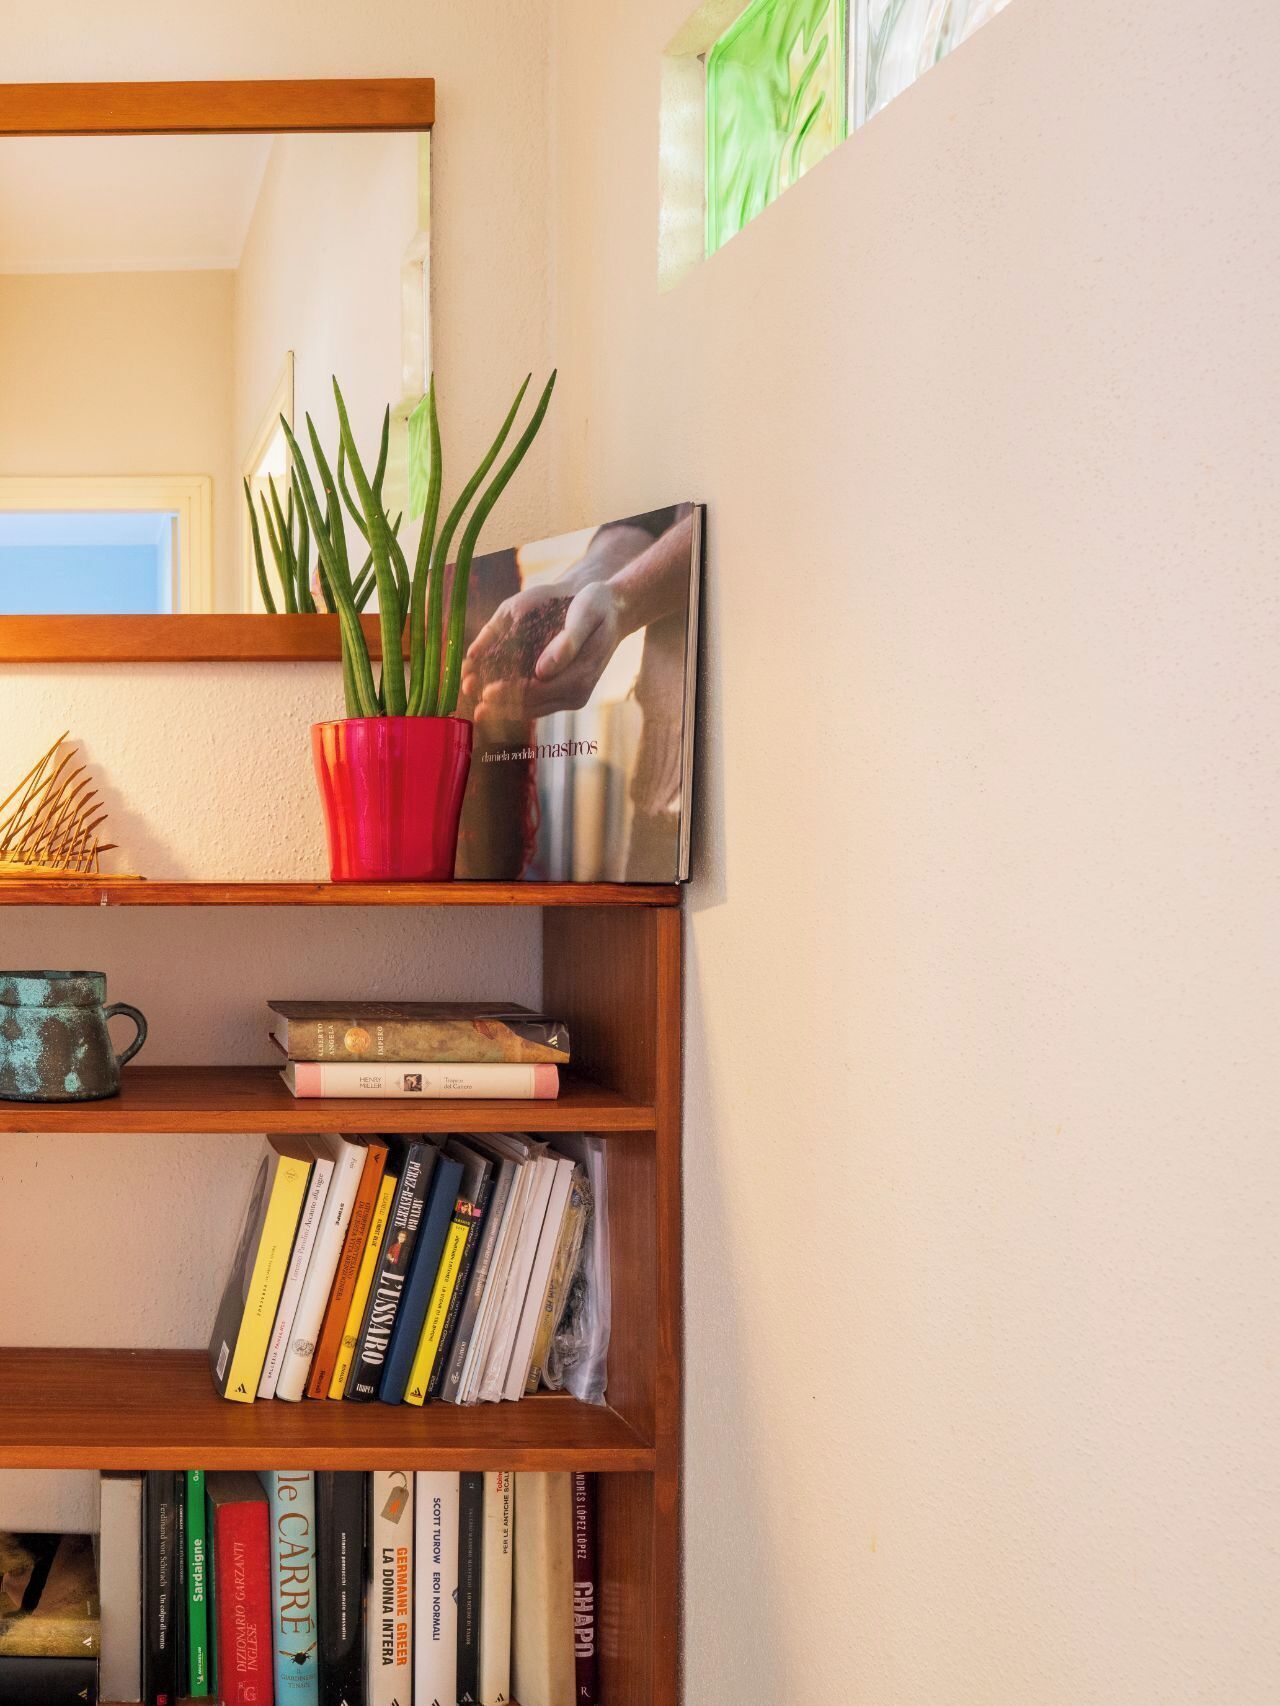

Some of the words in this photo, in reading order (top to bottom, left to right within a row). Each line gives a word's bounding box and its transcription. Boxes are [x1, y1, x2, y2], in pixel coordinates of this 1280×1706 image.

[481, 751, 509, 763] daniela
[536, 739, 598, 759] mastros
[316, 1022, 324, 1057] ALBERTO
[327, 1024, 336, 1056] ANGELA
[376, 1025, 385, 1056] IMPERO
[312, 1188, 321, 1201] alla
[316, 1173, 325, 1188] tigre
[394, 1161, 422, 1229] PÉREZ-REVERTE
[303, 1202, 317, 1229] Accanto
[352, 1207, 364, 1237] QUESTA
[358, 1202, 371, 1236] GIUSEPPE
[407, 1198, 424, 1231] ARTURO
[347, 1238, 364, 1280] MONTESANO
[348, 1237, 357, 1253] VITA
[291, 1253, 305, 1282] Lorenzo
[361, 1269, 406, 1365] L'USSARO
[277, 1473, 311, 1502] le
[159, 1503, 168, 1540] Ferdinand
[432, 1497, 442, 1527] SCOTT
[576, 1504, 587, 1531] LÓPEZ
[432, 1529, 441, 1564] TUROW
[503, 1528, 509, 1538] LE
[576, 1533, 588, 1560] LÓPEZ
[159, 1556, 168, 1587] Schirach
[192, 1538, 204, 1602] Sardaigne
[382, 1547, 395, 1564] LA
[233, 1542, 247, 1602] GARZANTI
[277, 1512, 316, 1635] CARRÉ
[396, 1547, 408, 1617] GERMAINE
[432, 1571, 441, 1594] EROI
[160, 1594, 167, 1603] Un
[382, 1568, 395, 1614] DONNA
[157, 1604, 167, 1623] colpo
[432, 1597, 441, 1641] NORMALI
[573, 1581, 595, 1657] CHAPO
[235, 1605, 248, 1673] DIZIONARIO
[246, 1623, 259, 1672] INGLESE
[382, 1618, 394, 1667] INTERA
[396, 1622, 408, 1667] GREER
